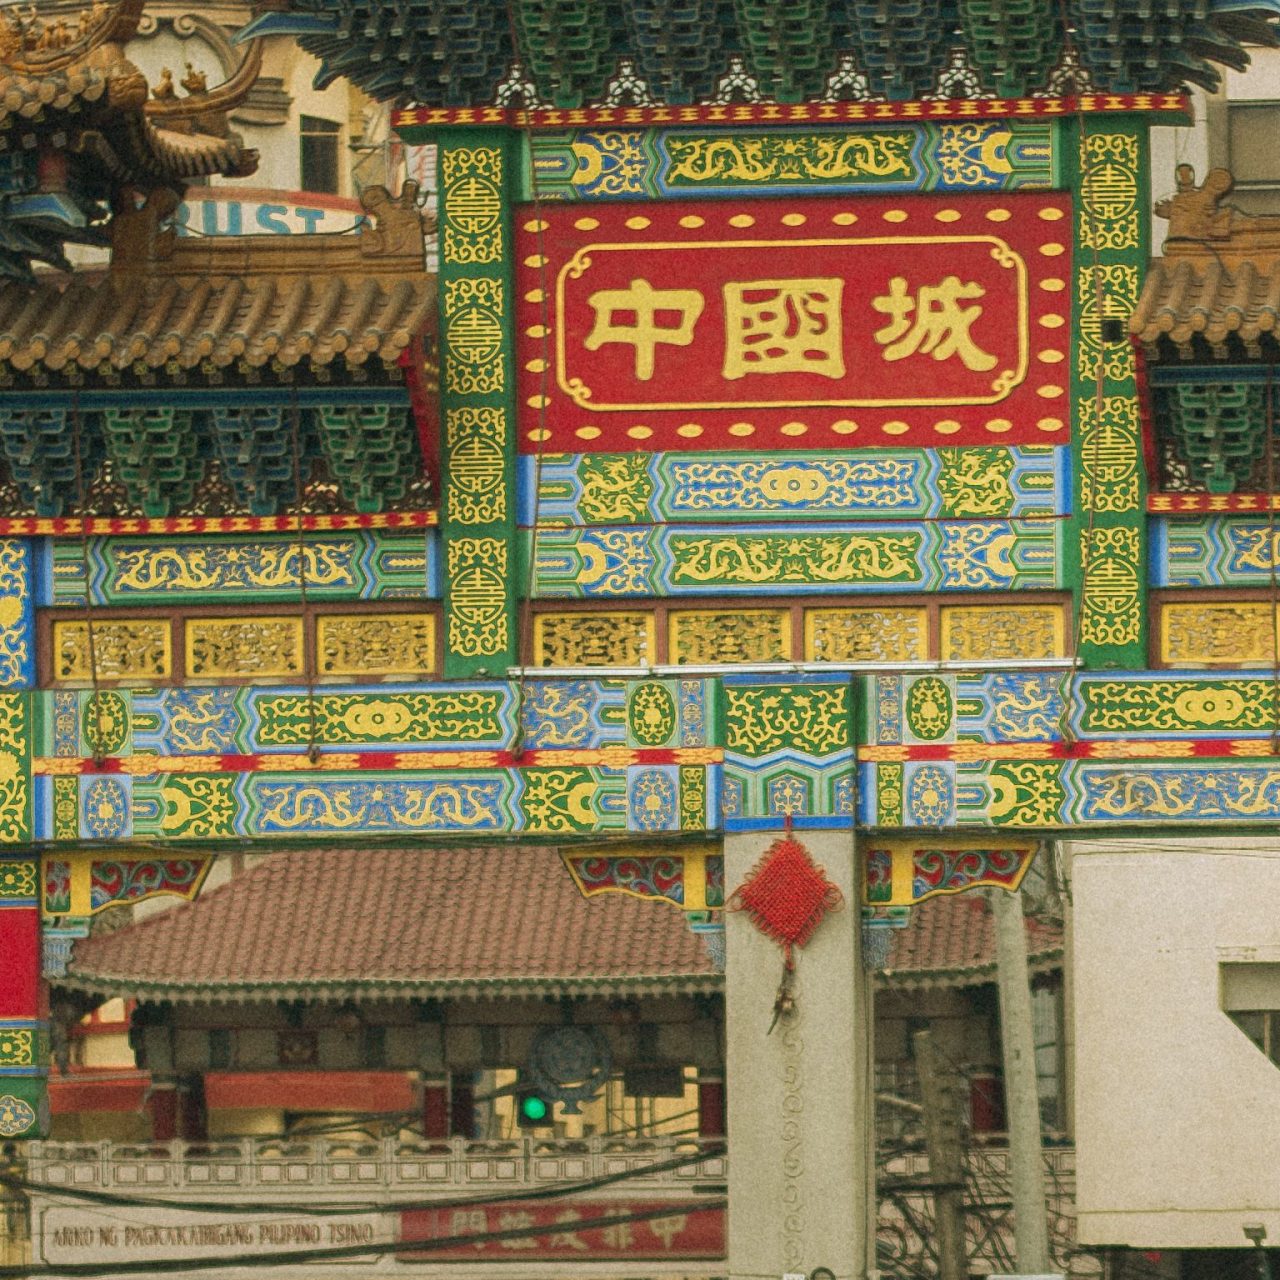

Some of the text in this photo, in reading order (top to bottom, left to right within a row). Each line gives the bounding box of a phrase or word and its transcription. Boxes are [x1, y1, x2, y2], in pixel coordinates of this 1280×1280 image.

[584, 276, 998, 381] 中國城
[99, 1225, 118, 1246] NG
[259, 1224, 320, 1244] PILIPINO
[328, 1223, 373, 1243] TSINO
